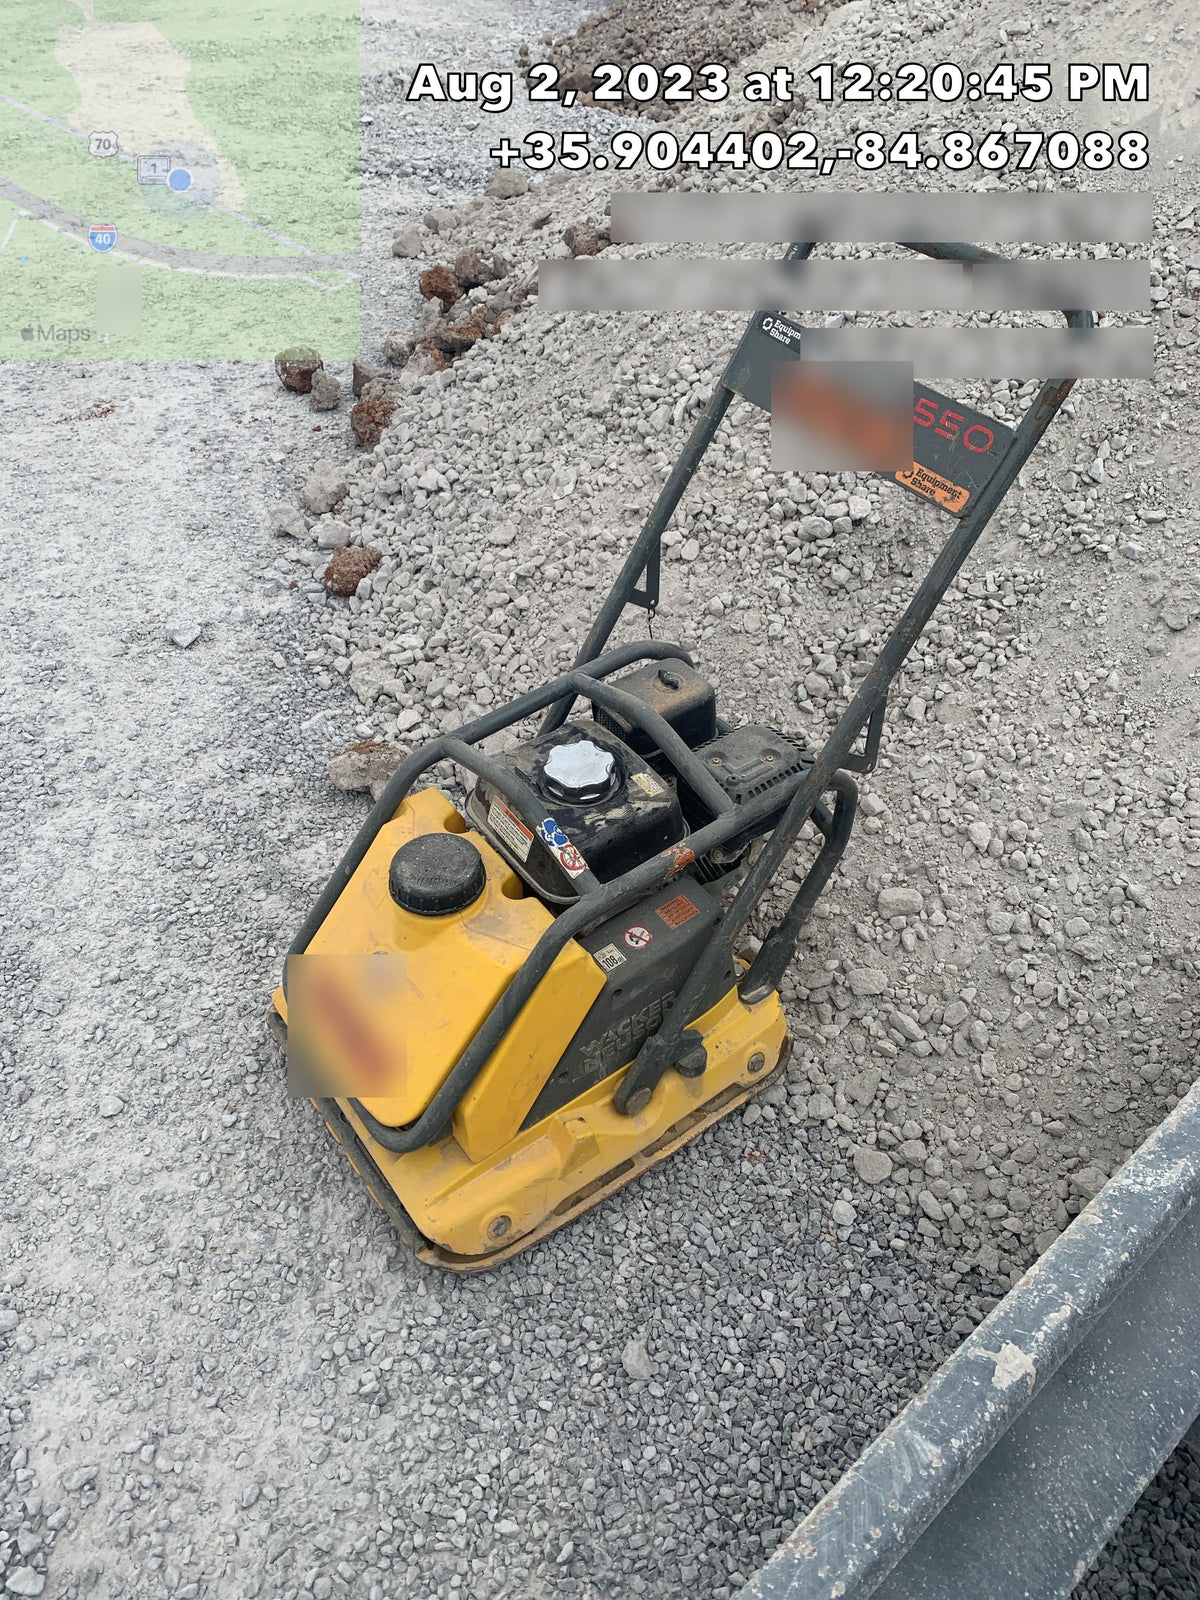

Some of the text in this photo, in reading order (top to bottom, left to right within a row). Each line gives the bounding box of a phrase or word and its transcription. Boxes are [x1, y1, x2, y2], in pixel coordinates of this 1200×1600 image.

[769, 328, 791, 345] Share
[774, 319, 801, 340] Equipm
[913, 395, 994, 453] 550
[910, 477, 936, 497] Share
[915, 468, 963, 500] Equipment
[602, 955, 619, 969] 108
[579, 990, 677, 1057] WACKER
[583, 1014, 664, 1079] NEUSO
